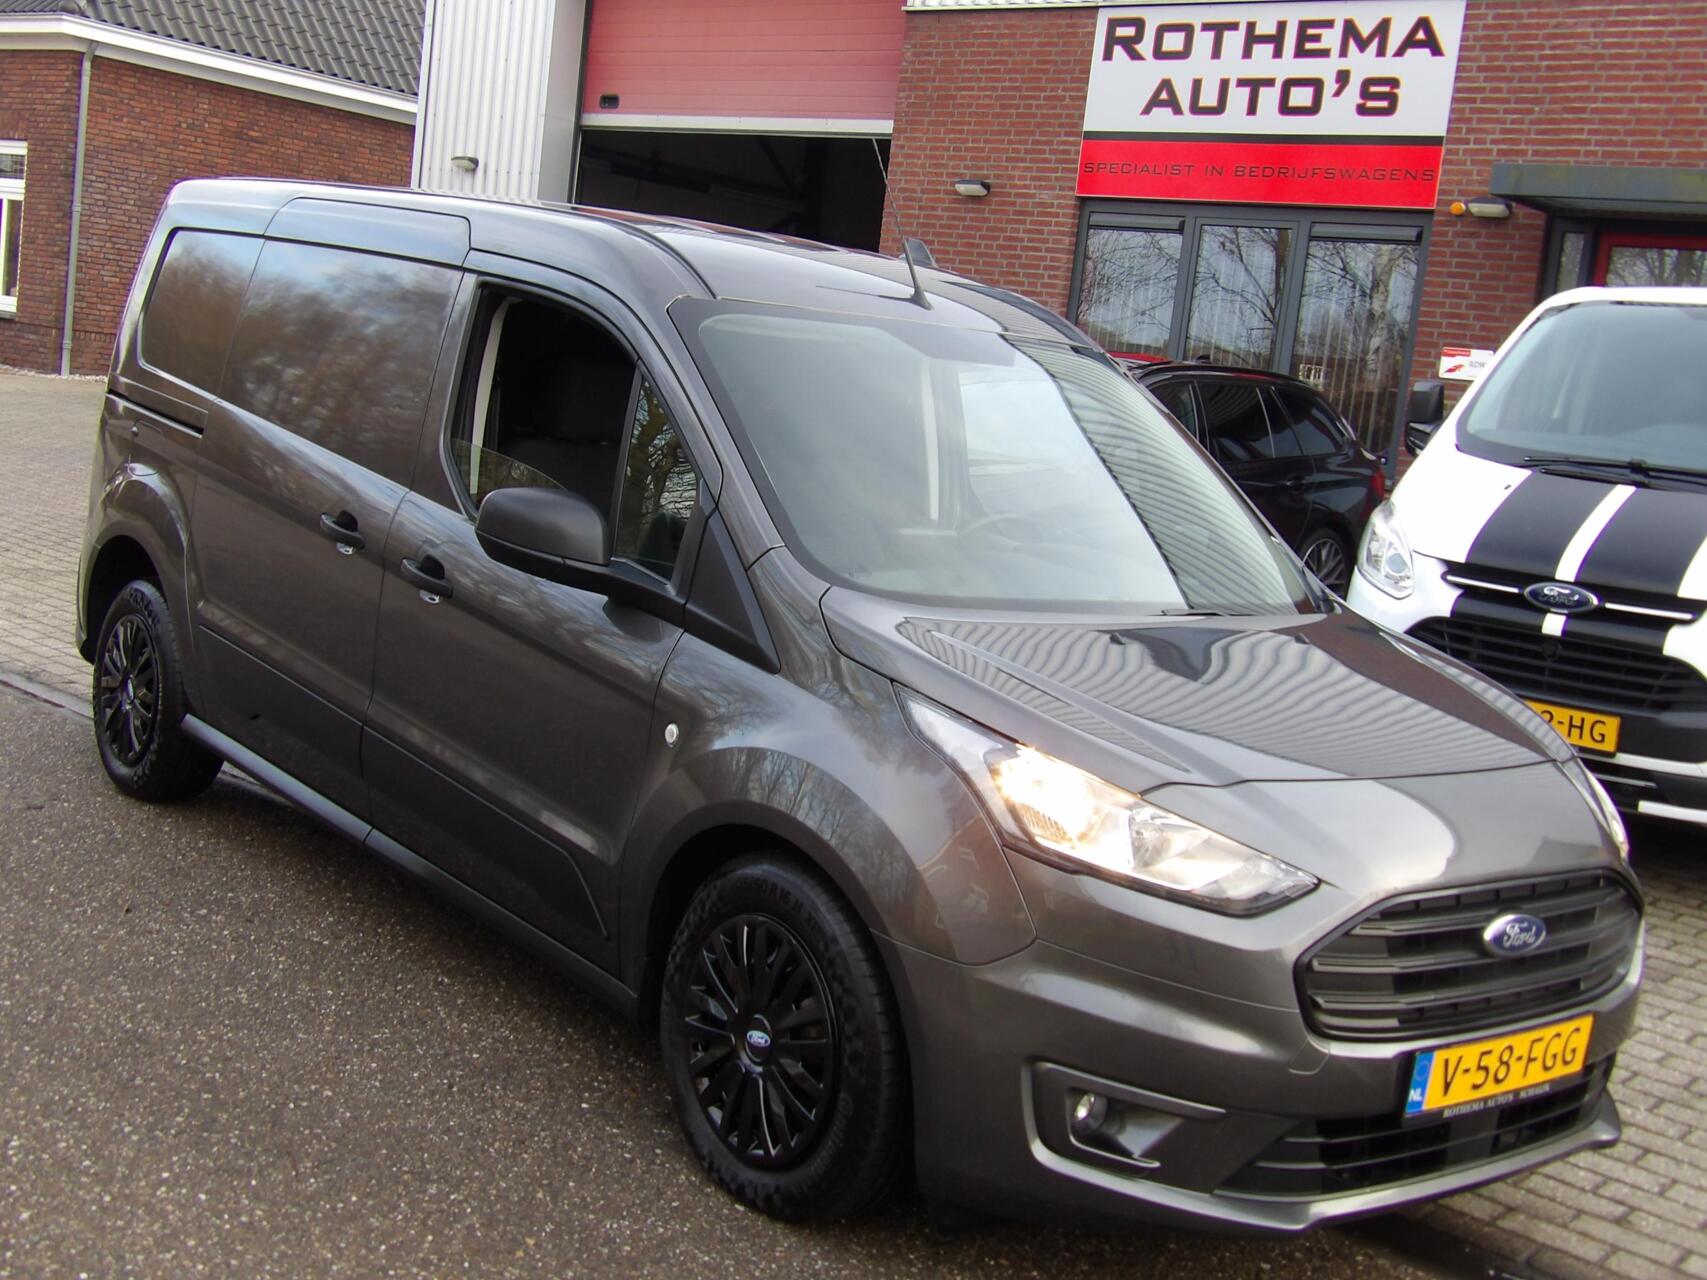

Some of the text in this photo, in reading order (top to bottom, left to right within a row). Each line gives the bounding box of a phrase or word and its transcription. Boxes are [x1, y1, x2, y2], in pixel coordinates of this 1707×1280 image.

[1102, 15, 1445, 61] ROTHEMA
[1140, 69, 1401, 116] AUTO'S
[1083, 162, 1435, 182] SPECIALIST IN BEDRIJFSWAGENS
[1503, 922, 1536, 949] Ford
[1442, 1027, 1581, 1097] V-58-FGG
[1409, 1089, 1423, 1102] NL
